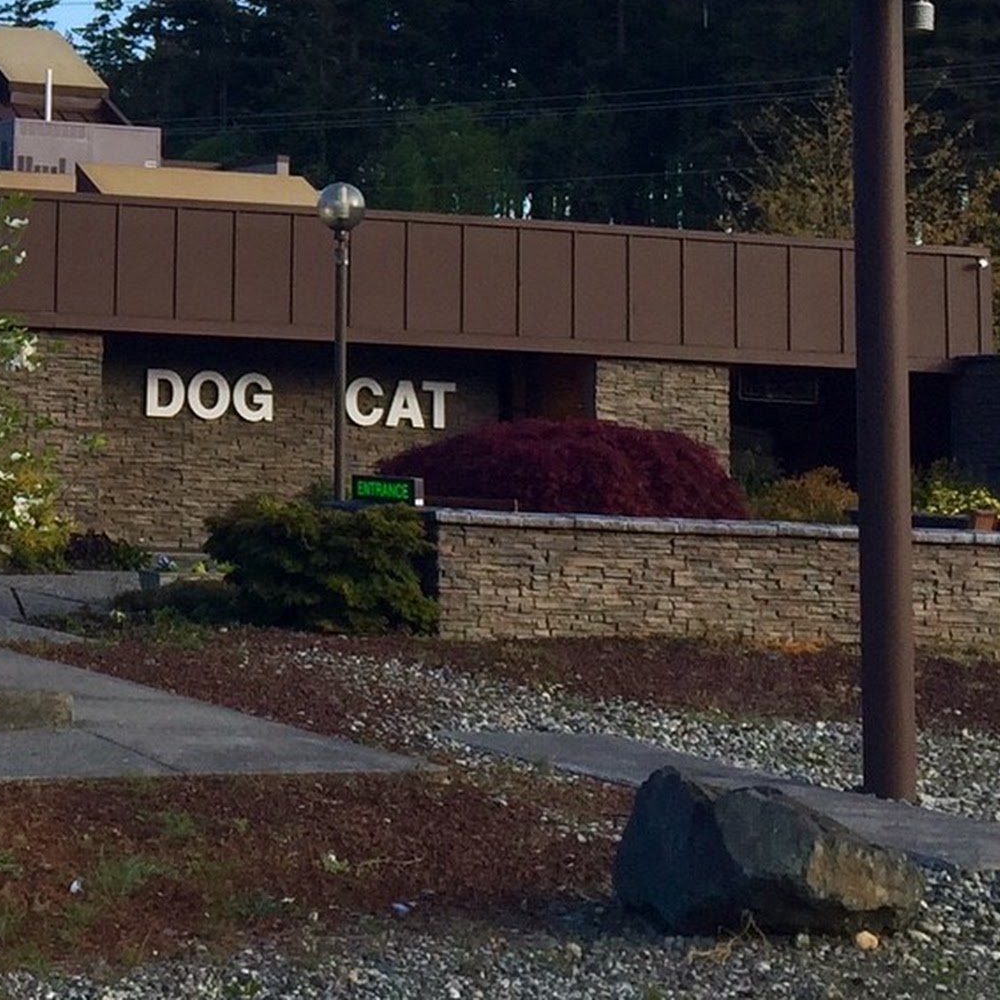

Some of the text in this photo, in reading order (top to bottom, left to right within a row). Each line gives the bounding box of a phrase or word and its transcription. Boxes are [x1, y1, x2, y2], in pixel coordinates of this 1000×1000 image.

[146, 368, 273, 422] DOG
[345, 377, 456, 429] CAT
[357, 481, 409, 499] ENTRANCE
